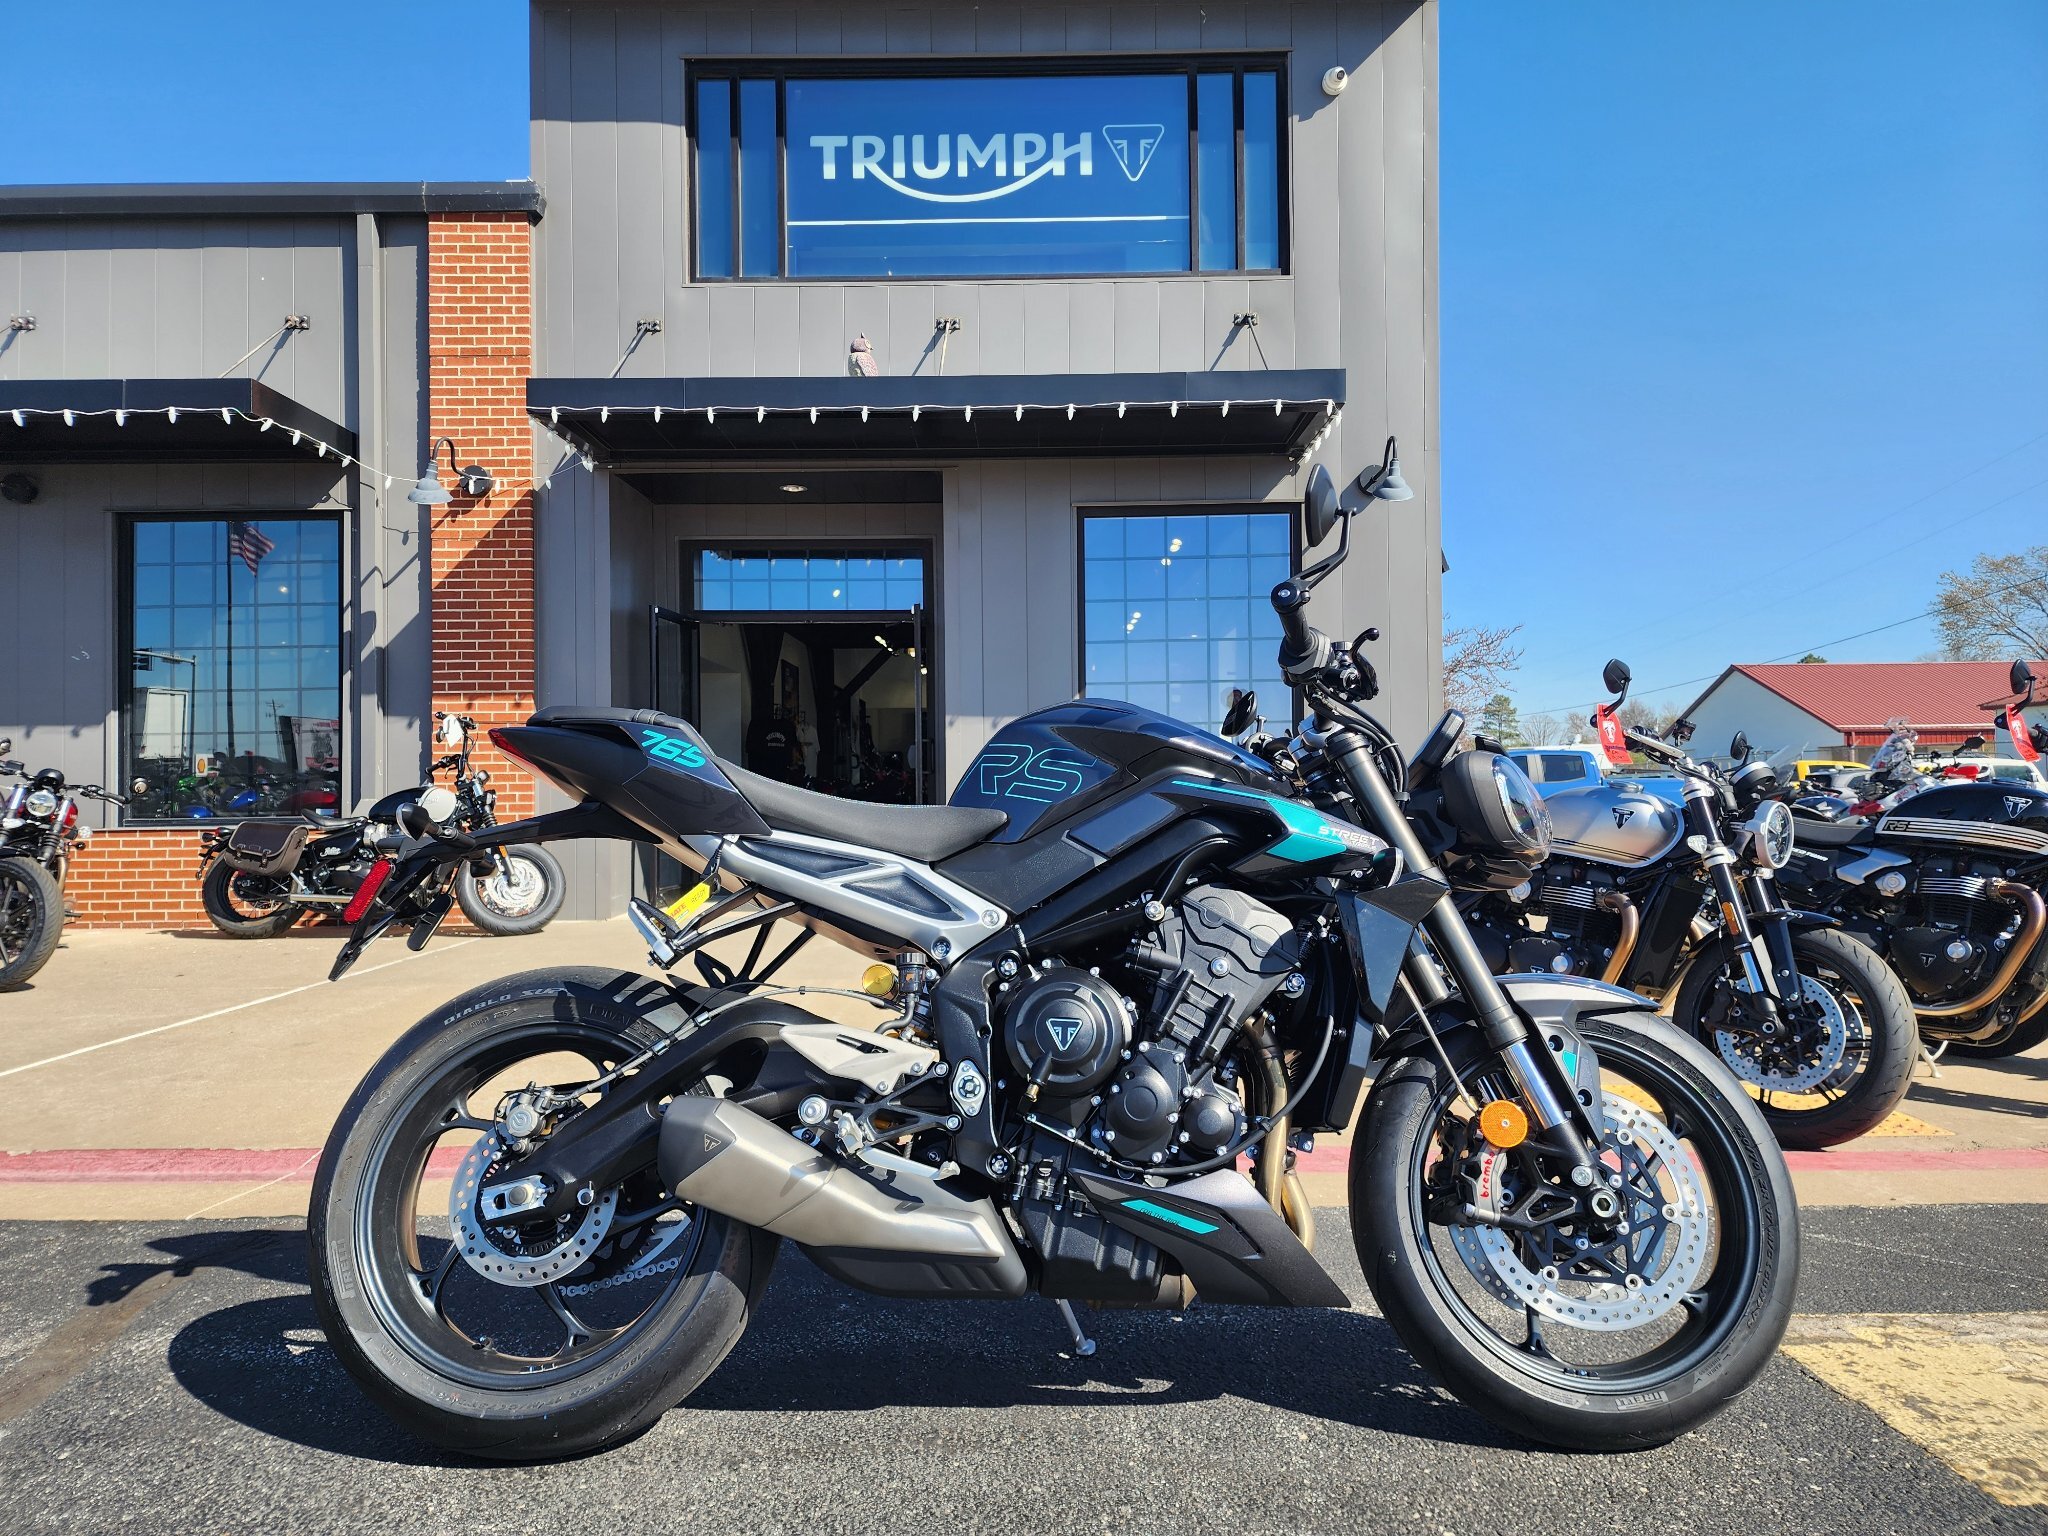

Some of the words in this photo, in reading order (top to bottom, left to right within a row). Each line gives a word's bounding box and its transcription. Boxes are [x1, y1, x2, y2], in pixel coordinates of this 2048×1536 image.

[809, 131, 1092, 203] TRIUMPH
[641, 729, 706, 768] 765
[980, 743, 1098, 803] RS
[1319, 825, 1380, 846] STREET
[1883, 820, 1909, 831] RS
[444, 993, 512, 1026] DIABLO
[1480, 1151, 1495, 1199] brembo
[331, 1238, 356, 1300] PIRELLI
[1615, 1390, 1669, 1411] PIRELLI
